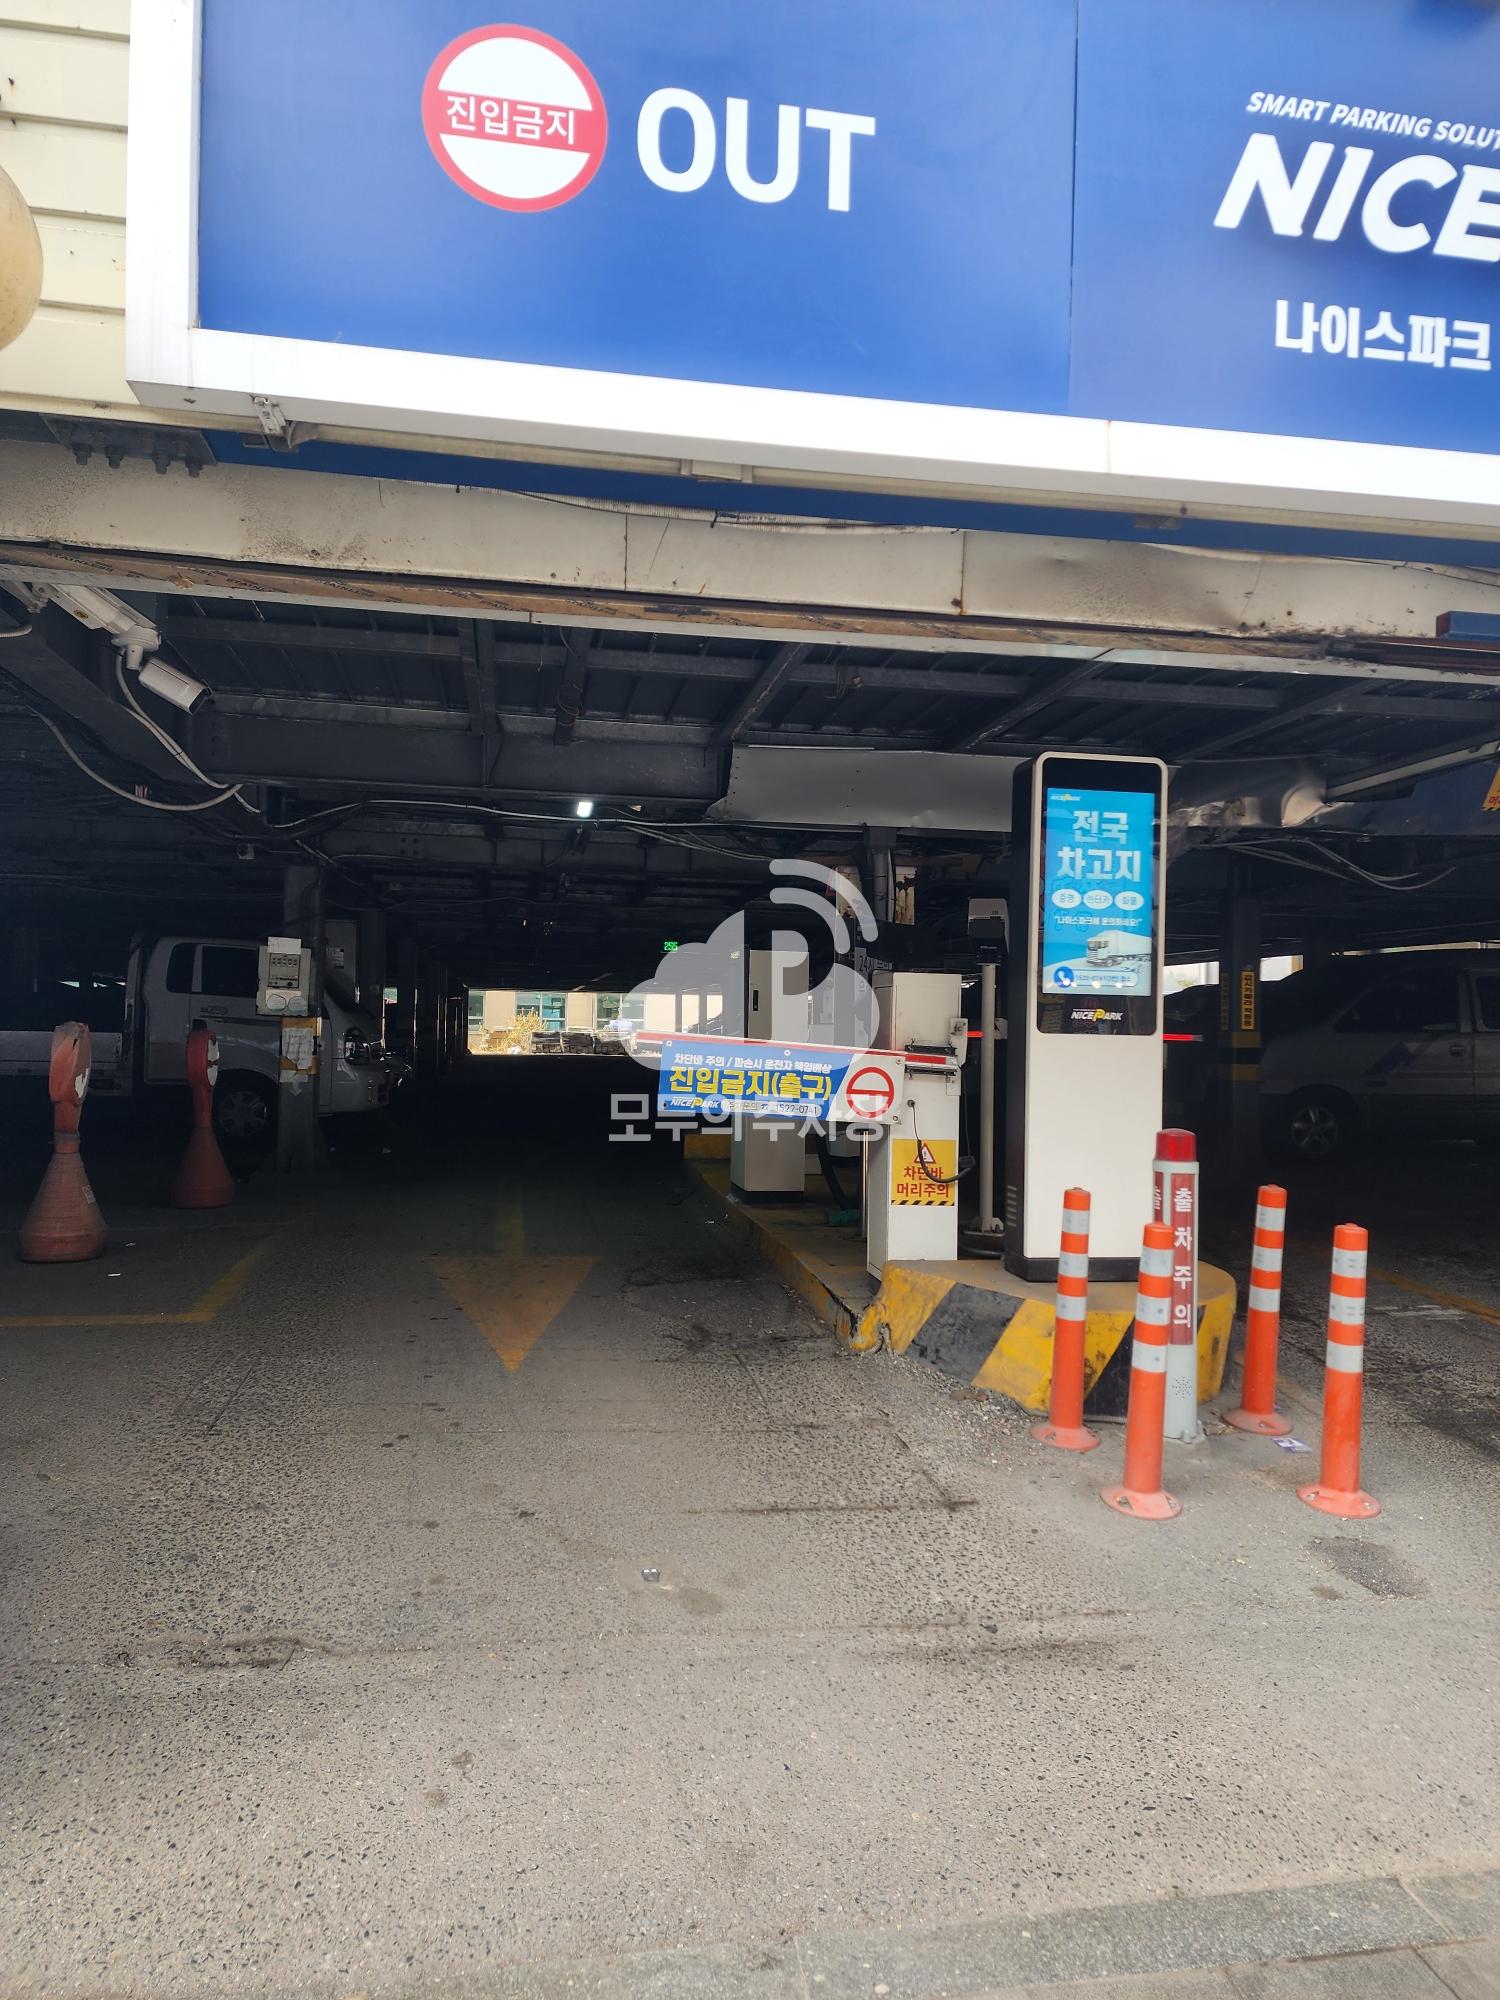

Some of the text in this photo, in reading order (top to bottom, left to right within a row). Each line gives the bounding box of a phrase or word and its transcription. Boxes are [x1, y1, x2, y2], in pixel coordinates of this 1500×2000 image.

[446, 95, 576, 144] 진입금지
[1246, 91, 1330, 121] SMART
[1330, 104, 1432, 138] PARKING
[637, 88, 876, 212] OUT
[1213, 132, 1500, 262] NICE
[1275, 299, 1492, 371] 나이스파크
[1073, 811, 1129, 844] 전국
[1057, 847, 1141, 883] 차고지
[1071, 1008, 1123, 1022] NICEPARK
[674, 1054, 703, 1065] 차단바
[706, 1056, 724, 1067] 주의
[734, 1057, 762, 1070] 파손시
[764, 1059, 793, 1071] 운전자
[669, 1066, 832, 1101] 진입금지(출구)
[670, 1097, 719, 1110] NICEPARK
[896, 1183, 950, 1198] 머리주의
[1173, 1187, 1193, 1328] 출차주의
